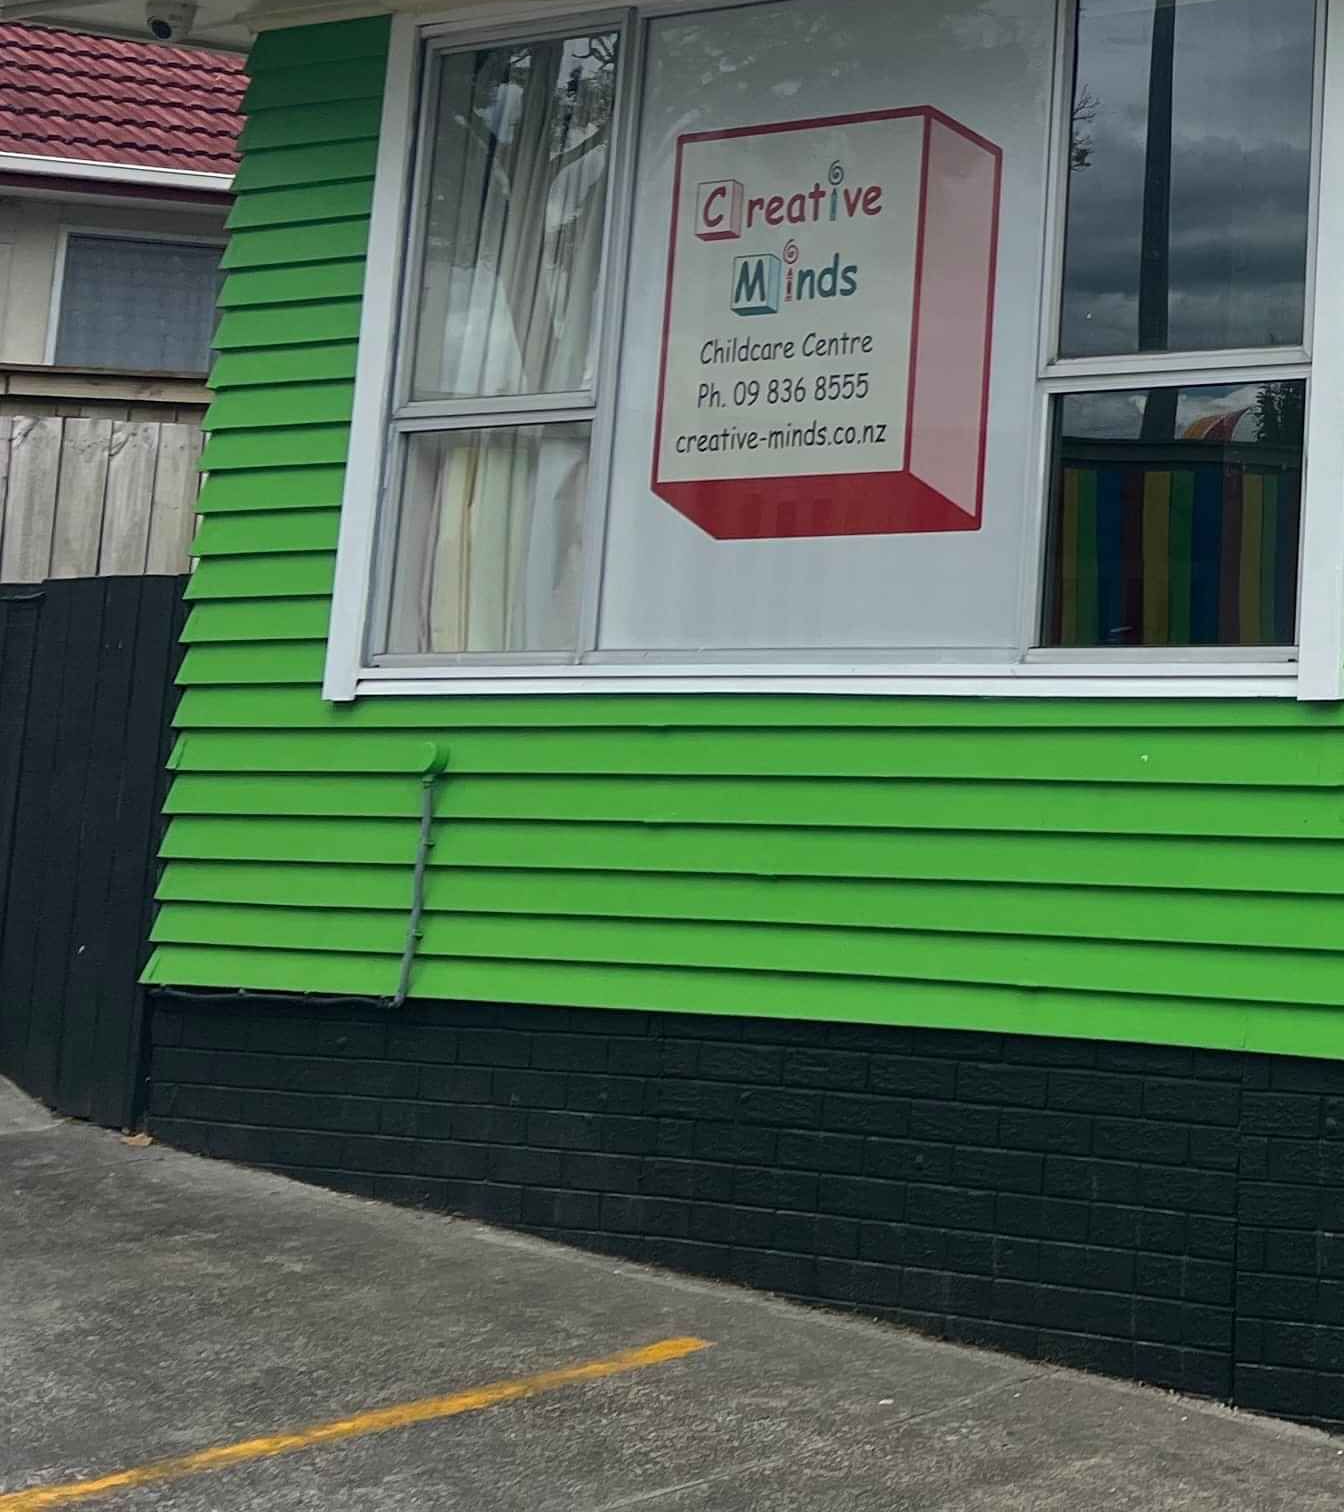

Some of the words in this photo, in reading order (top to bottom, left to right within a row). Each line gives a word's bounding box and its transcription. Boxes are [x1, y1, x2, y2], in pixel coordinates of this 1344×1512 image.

[703, 160, 882, 228] Creative
[734, 239, 858, 303] Minds
[700, 336, 794, 365] Childcare
[802, 332, 873, 357] Centre
[697, 382, 727, 408] Ph.
[733, 380, 760, 406] 09
[767, 377, 806, 404] 836
[814, 372, 869, 401] 8555
[676, 420, 887, 454] creative-minds.co.nz
